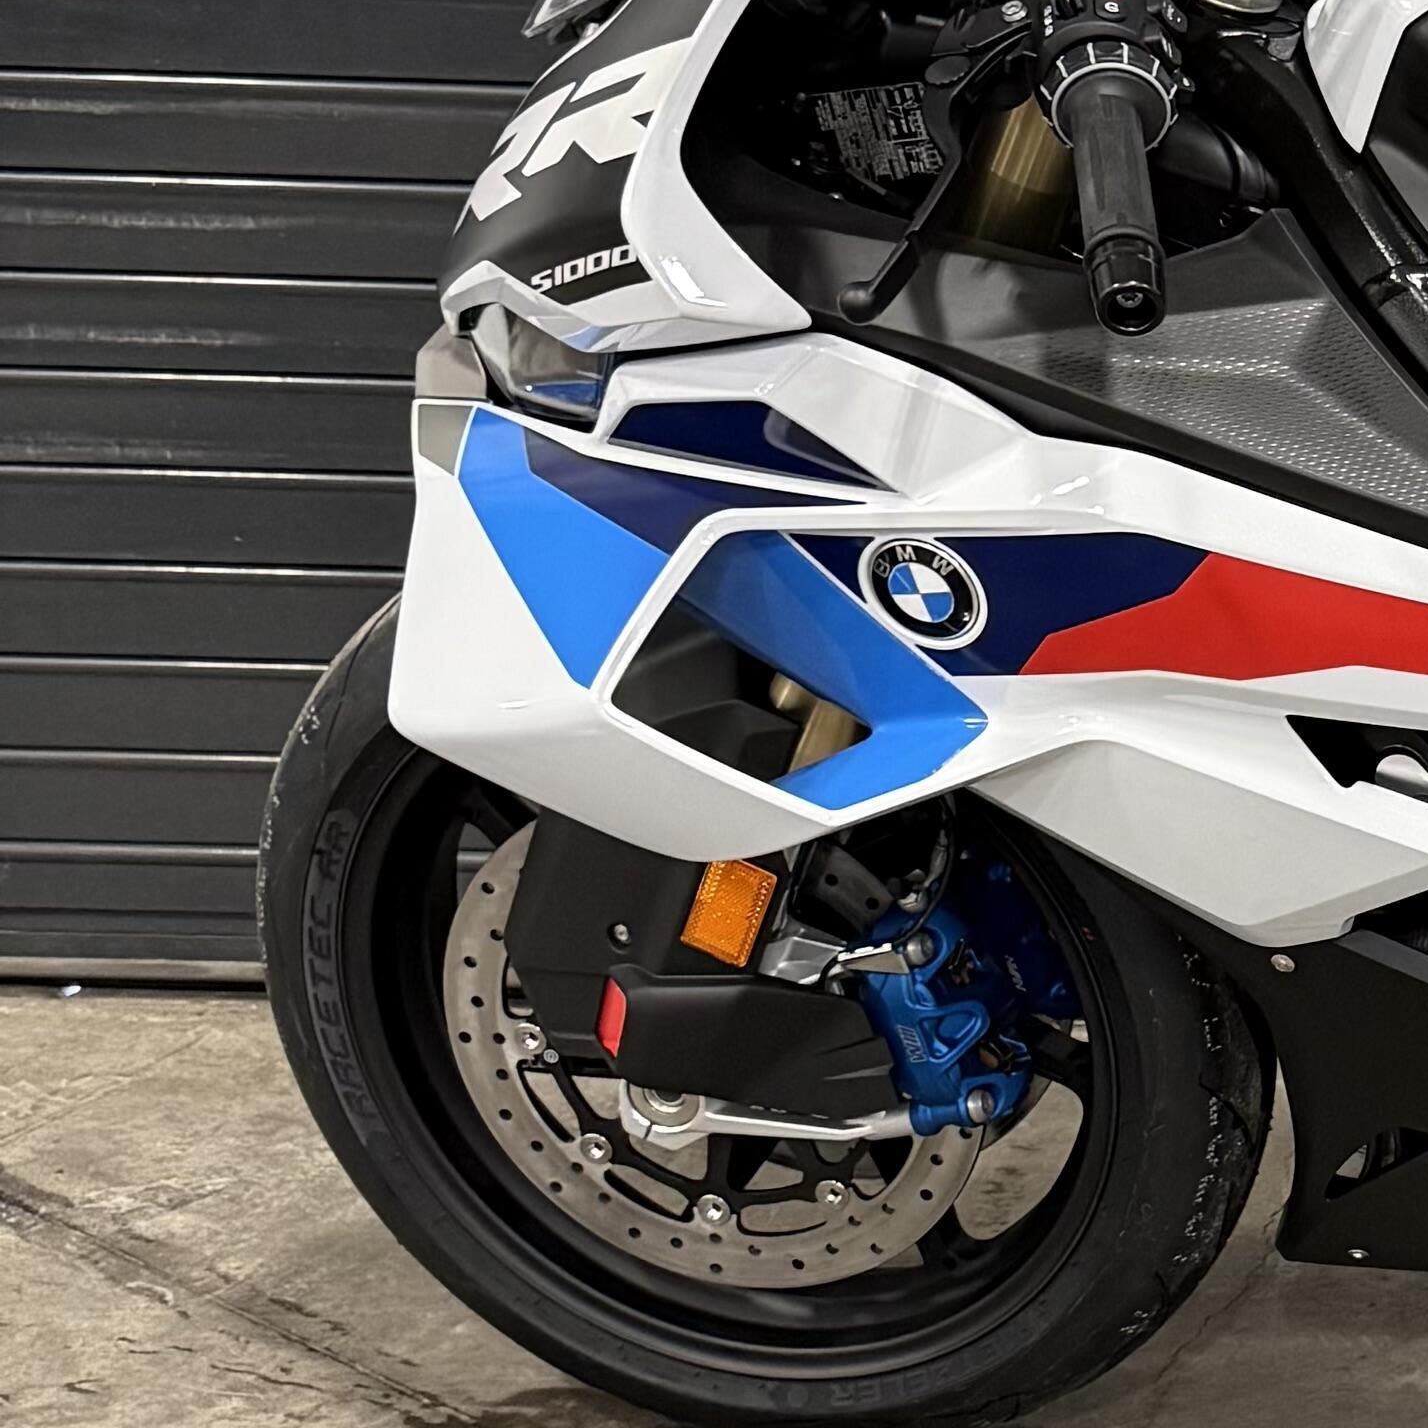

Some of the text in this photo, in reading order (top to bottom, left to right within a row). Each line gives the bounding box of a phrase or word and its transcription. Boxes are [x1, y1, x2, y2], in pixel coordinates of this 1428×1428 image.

[530, 244, 638, 293] S1000
[873, 545, 954, 578] BMW
[307, 894, 377, 1120] RACETEC
